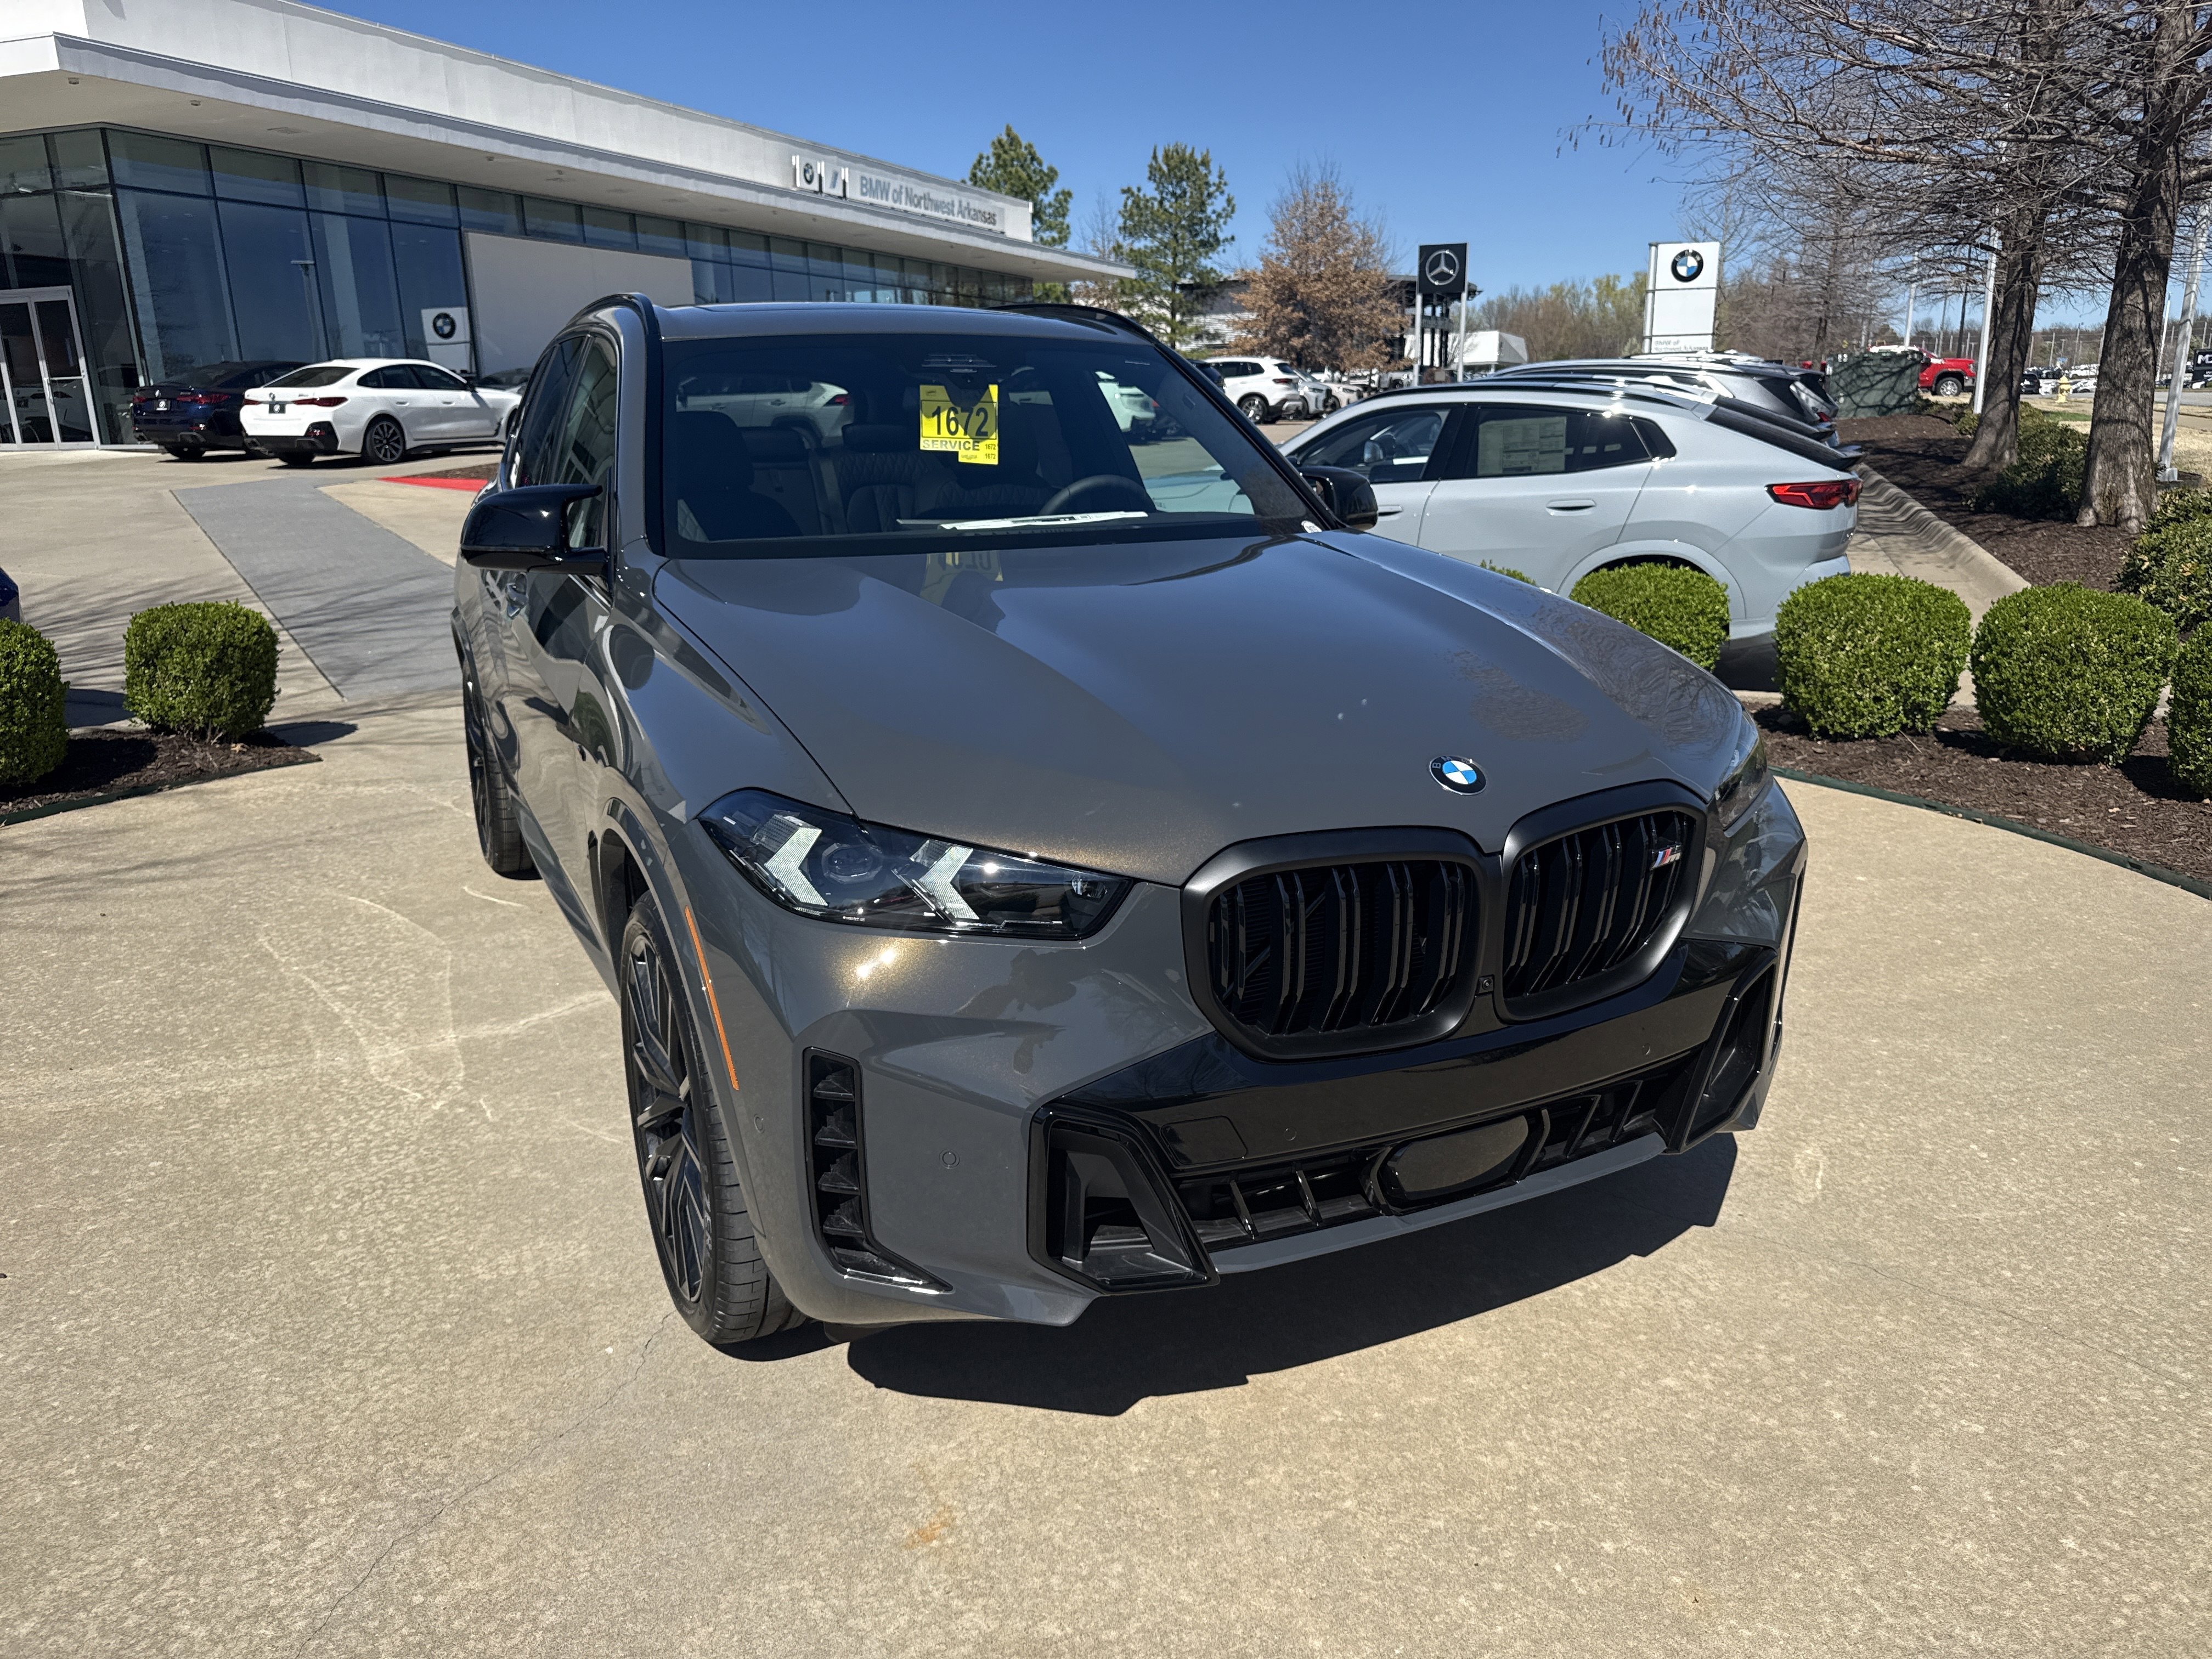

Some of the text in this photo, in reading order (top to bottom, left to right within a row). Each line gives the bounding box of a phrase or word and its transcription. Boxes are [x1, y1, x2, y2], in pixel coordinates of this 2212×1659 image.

[860, 175, 997, 227] BMW of Northwest Arkansas
[932, 406, 988, 436] 1672
[923, 439, 980, 450] SERVICE
